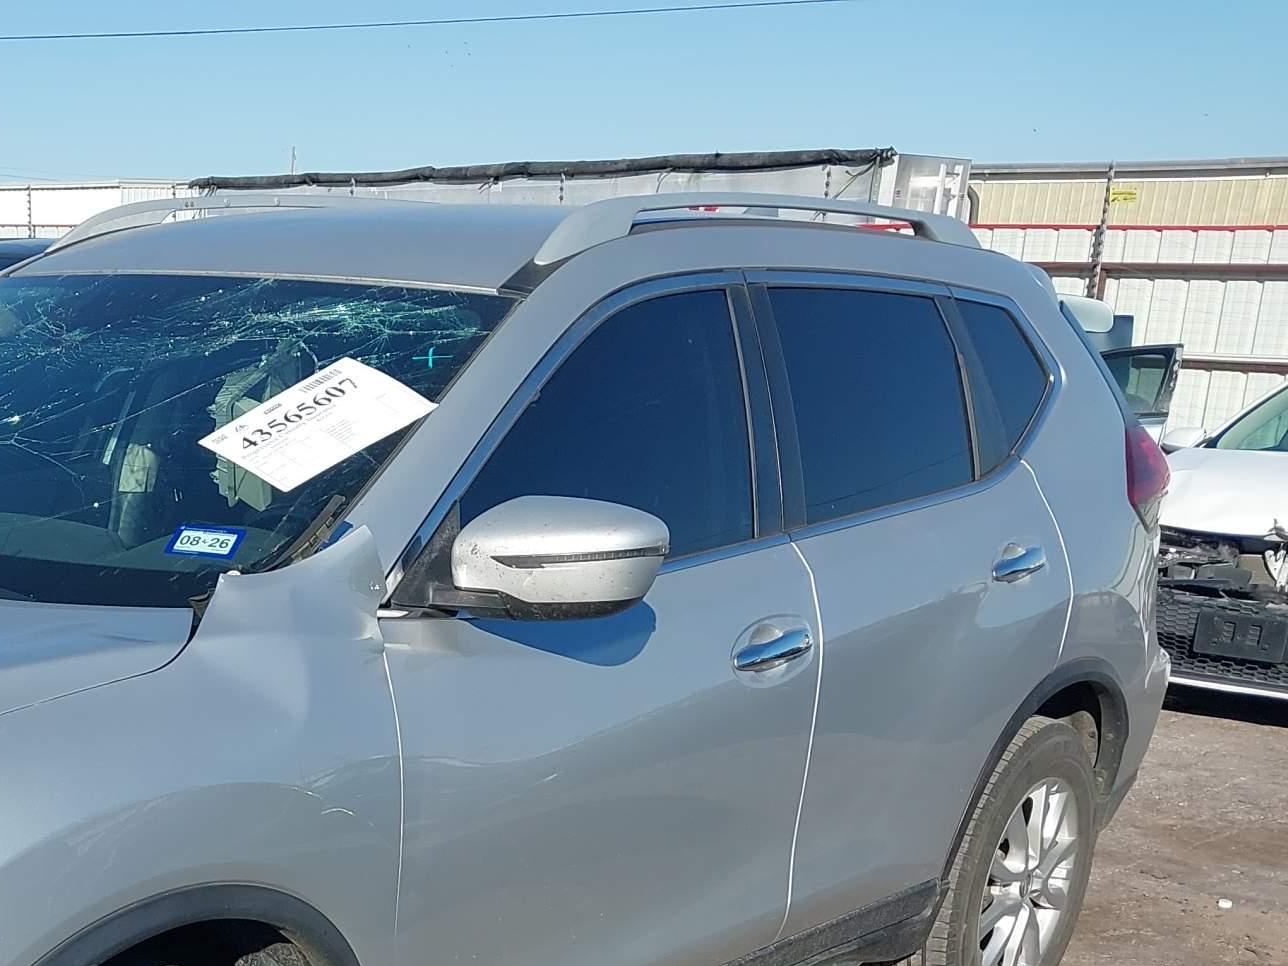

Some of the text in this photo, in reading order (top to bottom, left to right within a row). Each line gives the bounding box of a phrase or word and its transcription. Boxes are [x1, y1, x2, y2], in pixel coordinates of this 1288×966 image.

[241, 377, 359, 450] 43565607
[180, 534, 231, 549] 08 26
